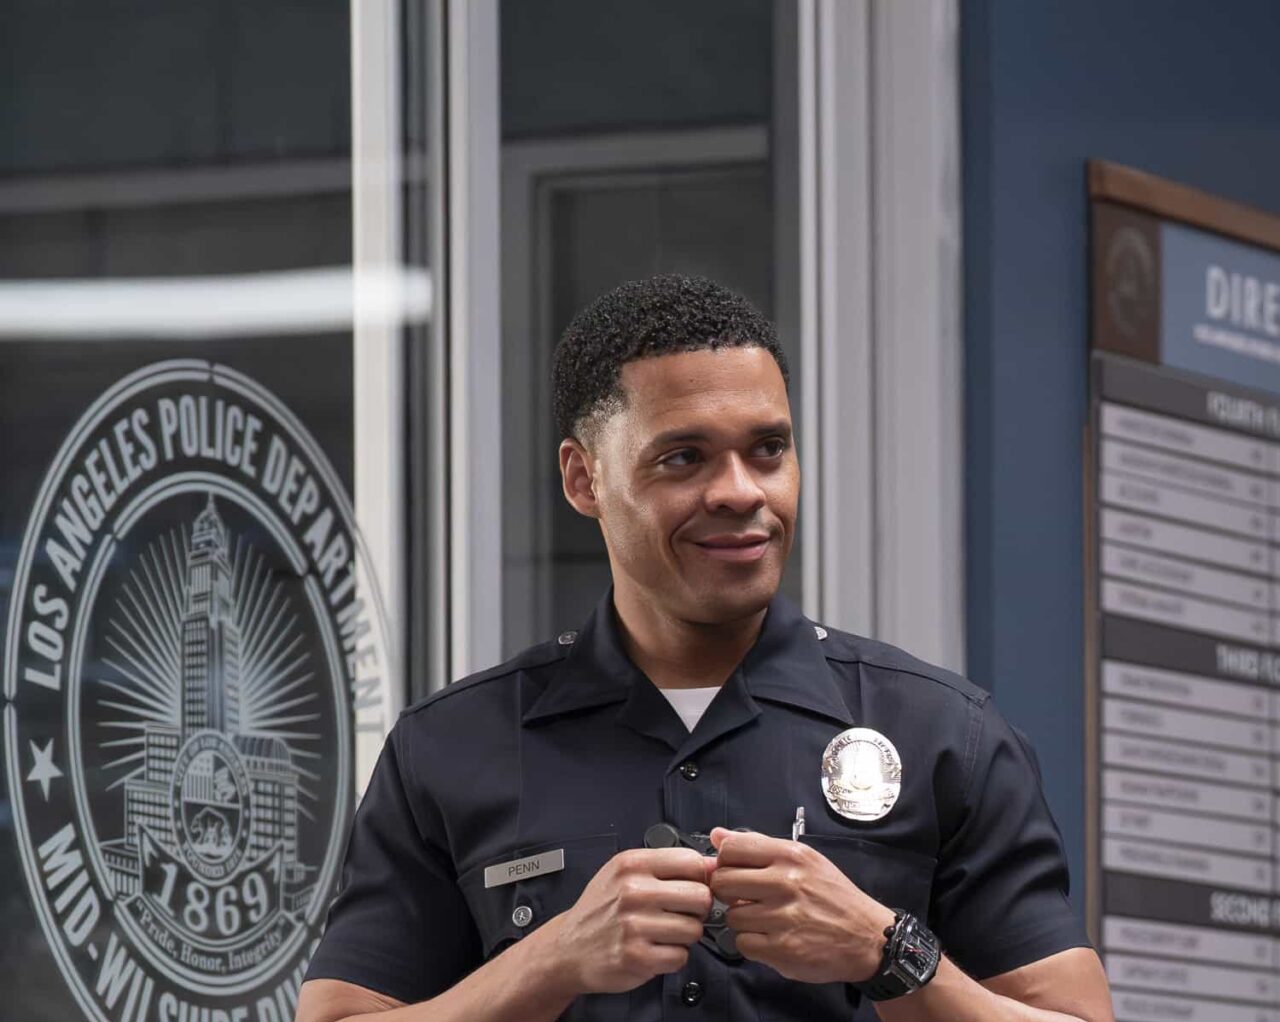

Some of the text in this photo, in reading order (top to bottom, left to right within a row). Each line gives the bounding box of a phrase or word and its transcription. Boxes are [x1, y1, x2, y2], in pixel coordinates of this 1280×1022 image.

[25, 394, 385, 738] LOS ANGELES POLICE DEPARTMENT
[508, 860, 540, 877] PENN
[154, 863, 268, 936] 1869
[181, 943, 226, 972] Honor,
